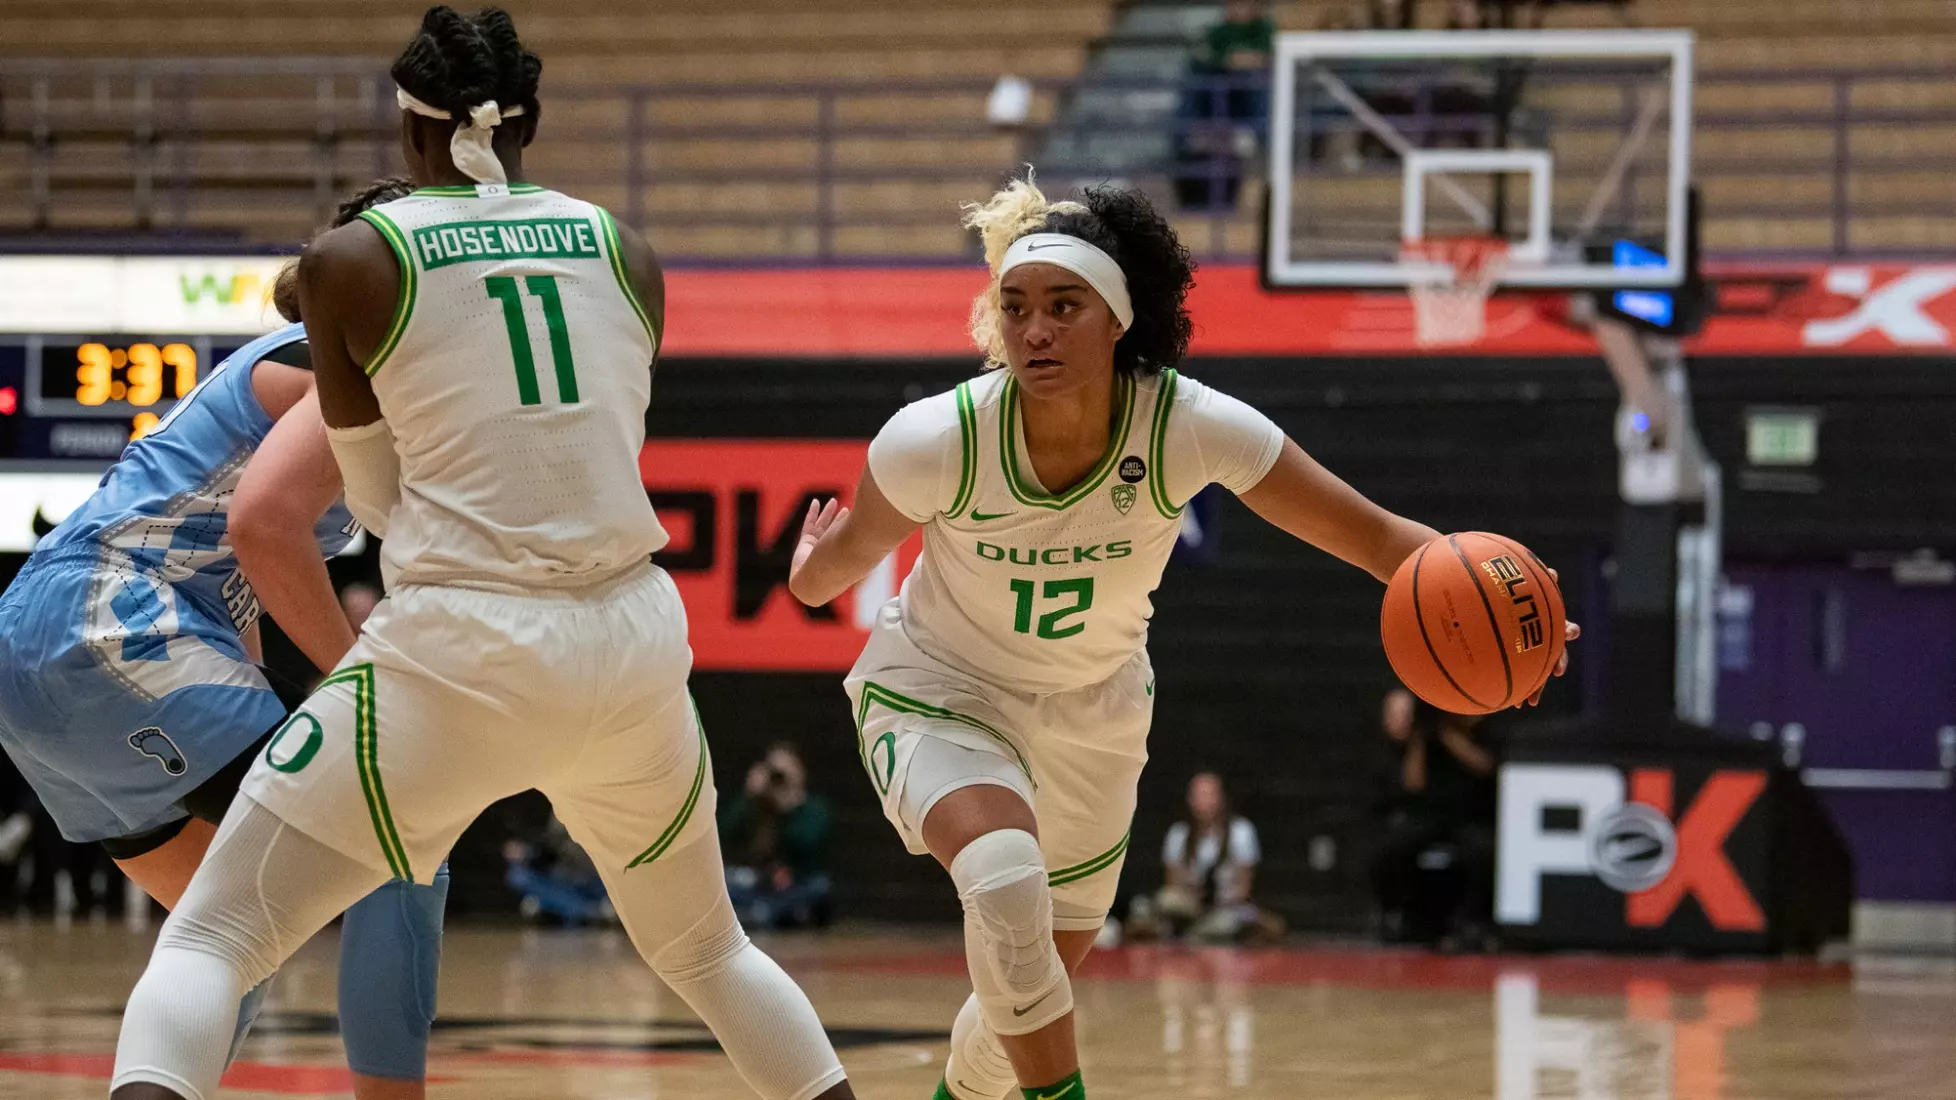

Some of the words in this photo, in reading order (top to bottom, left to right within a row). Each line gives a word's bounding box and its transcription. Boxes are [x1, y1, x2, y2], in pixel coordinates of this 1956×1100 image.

[418, 223, 596, 263] HOSENDOVE
[485, 275, 580, 406] 11
[76, 342, 197, 406] 3:37
[1121, 468, 1144, 477] RACISM
[1124, 461, 1141, 469] ANTI-
[1118, 497, 1131, 508] 12
[976, 540, 1132, 566] DUCKS
[1010, 577, 1094, 639] 12
[1489, 554, 1545, 652] ELITE
[1494, 763, 1768, 932] PK
